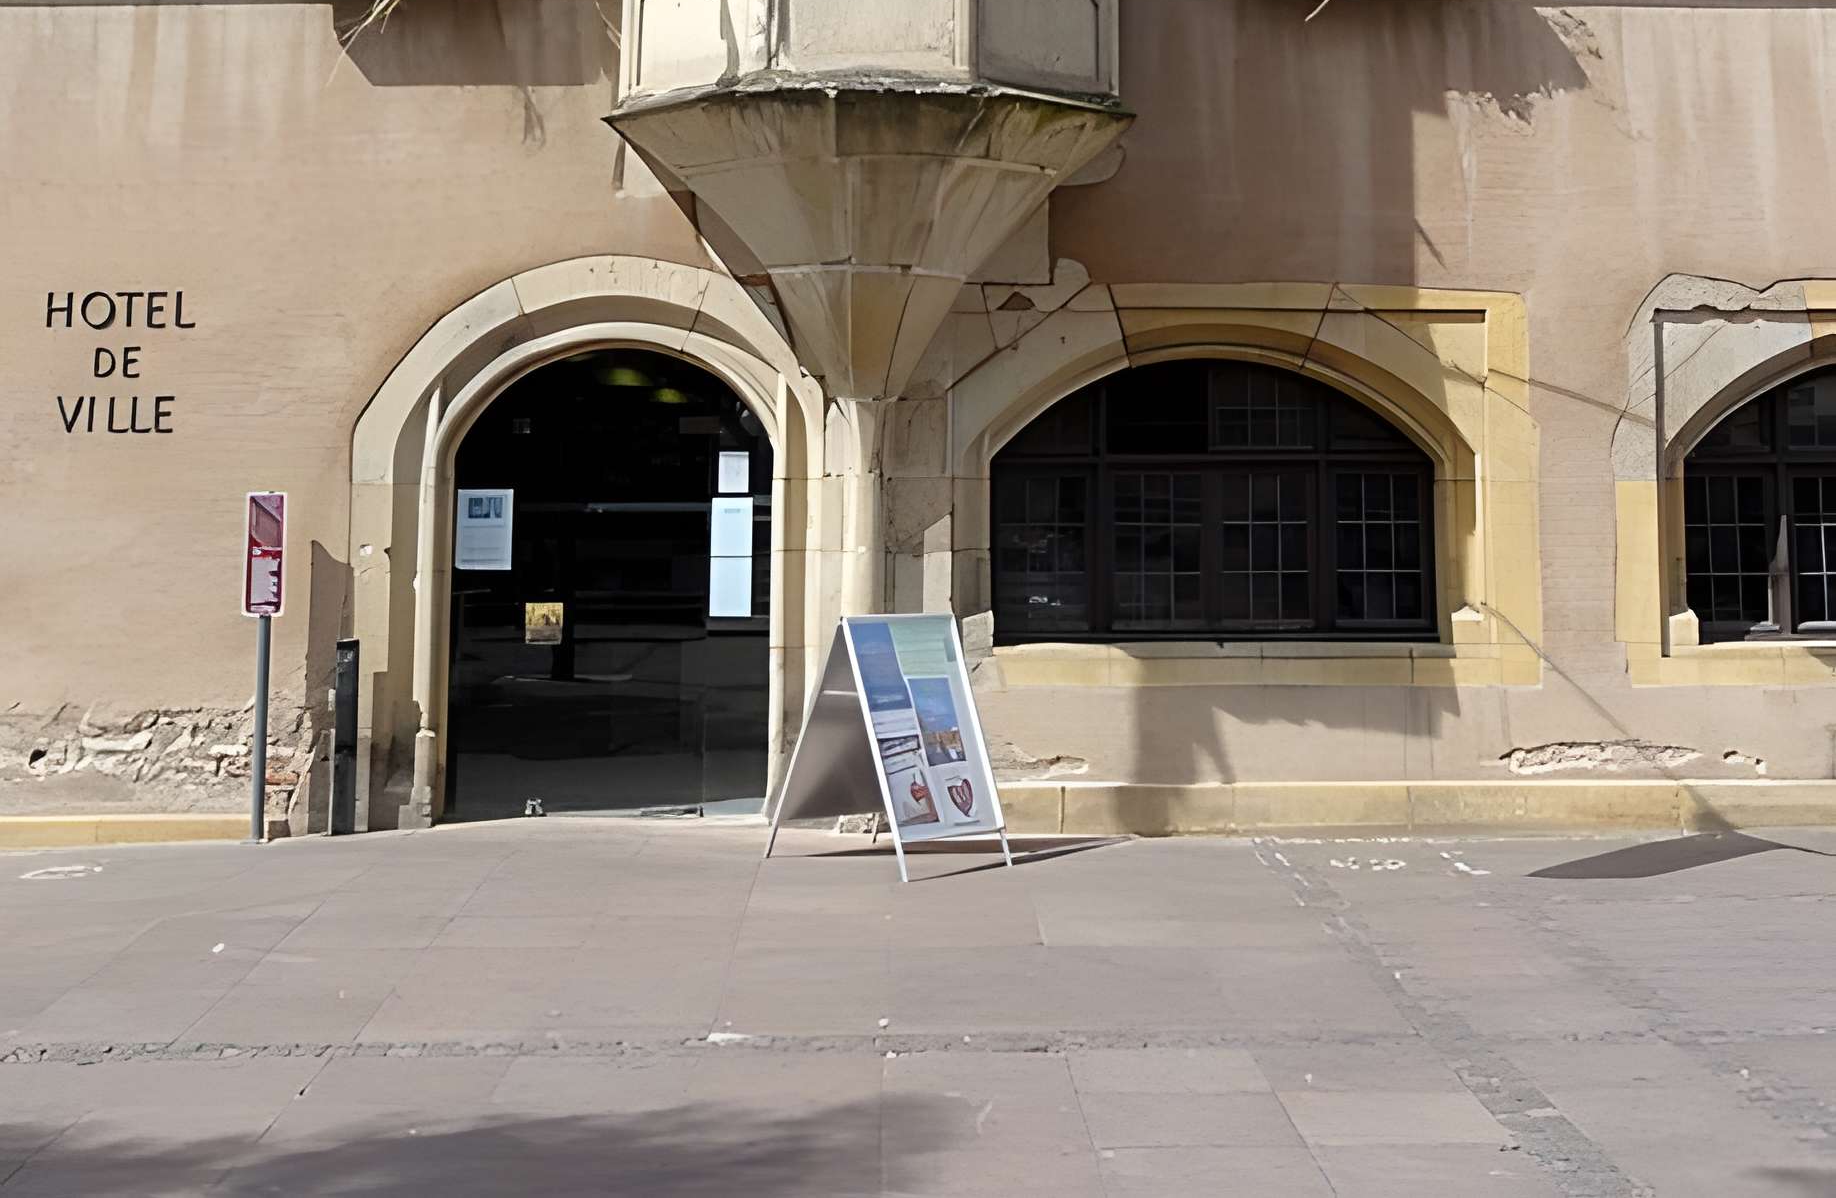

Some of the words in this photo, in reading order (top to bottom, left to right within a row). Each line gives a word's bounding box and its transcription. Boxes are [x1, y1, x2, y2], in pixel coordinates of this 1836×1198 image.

[46, 290, 196, 331] HOTEL
[93, 346, 142, 379] DE
[56, 395, 176, 434] VILLE
